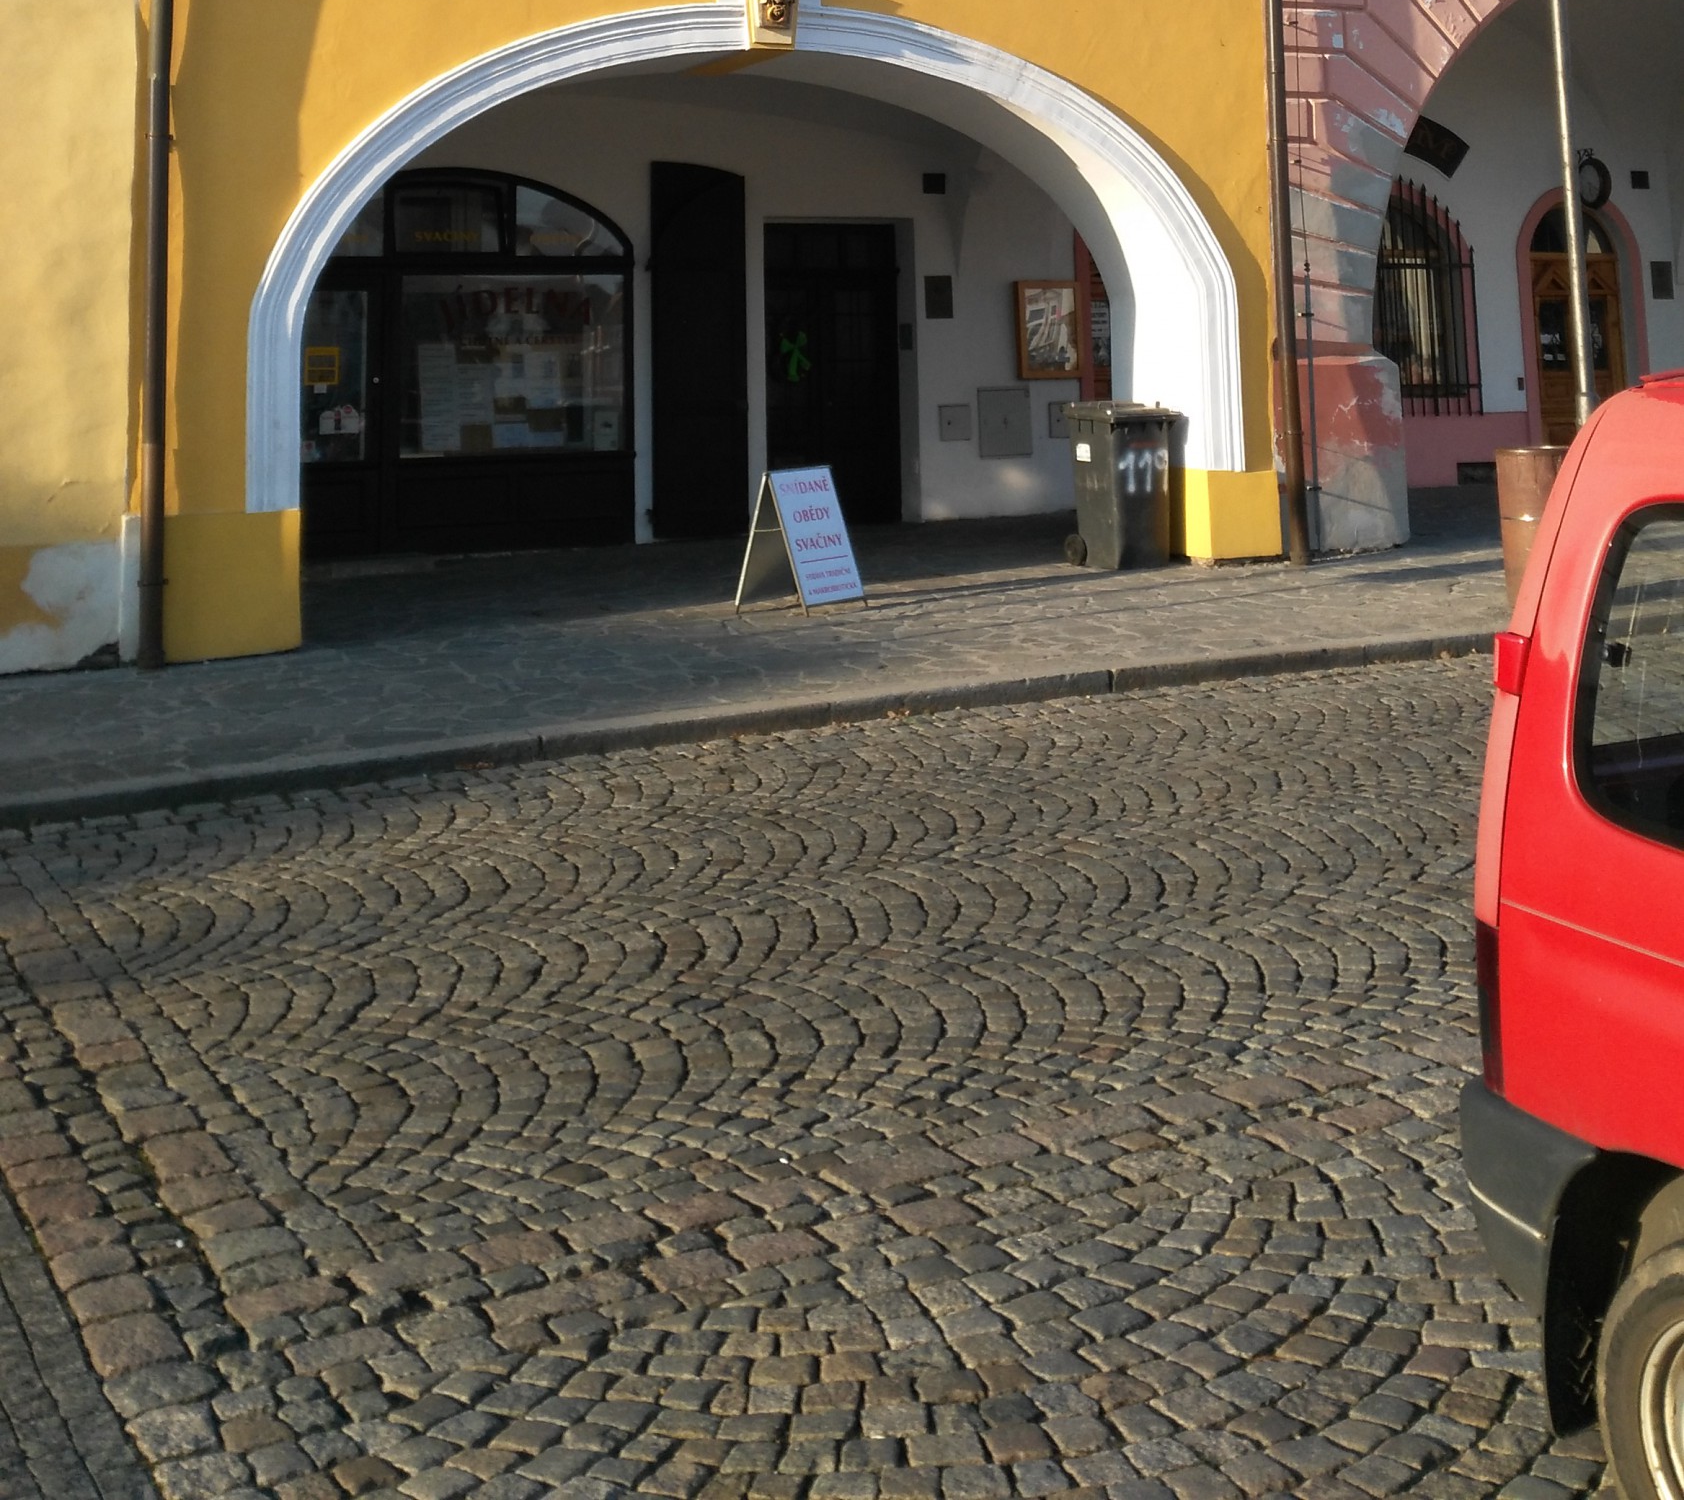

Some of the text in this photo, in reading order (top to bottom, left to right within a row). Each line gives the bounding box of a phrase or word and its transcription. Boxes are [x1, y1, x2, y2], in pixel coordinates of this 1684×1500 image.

[439, 284, 592, 333] JÍDELNA
[778, 476, 830, 496] SNÍDANĚ
[793, 505, 831, 523] OBĚDY
[795, 533, 842, 552] SVAČINY
